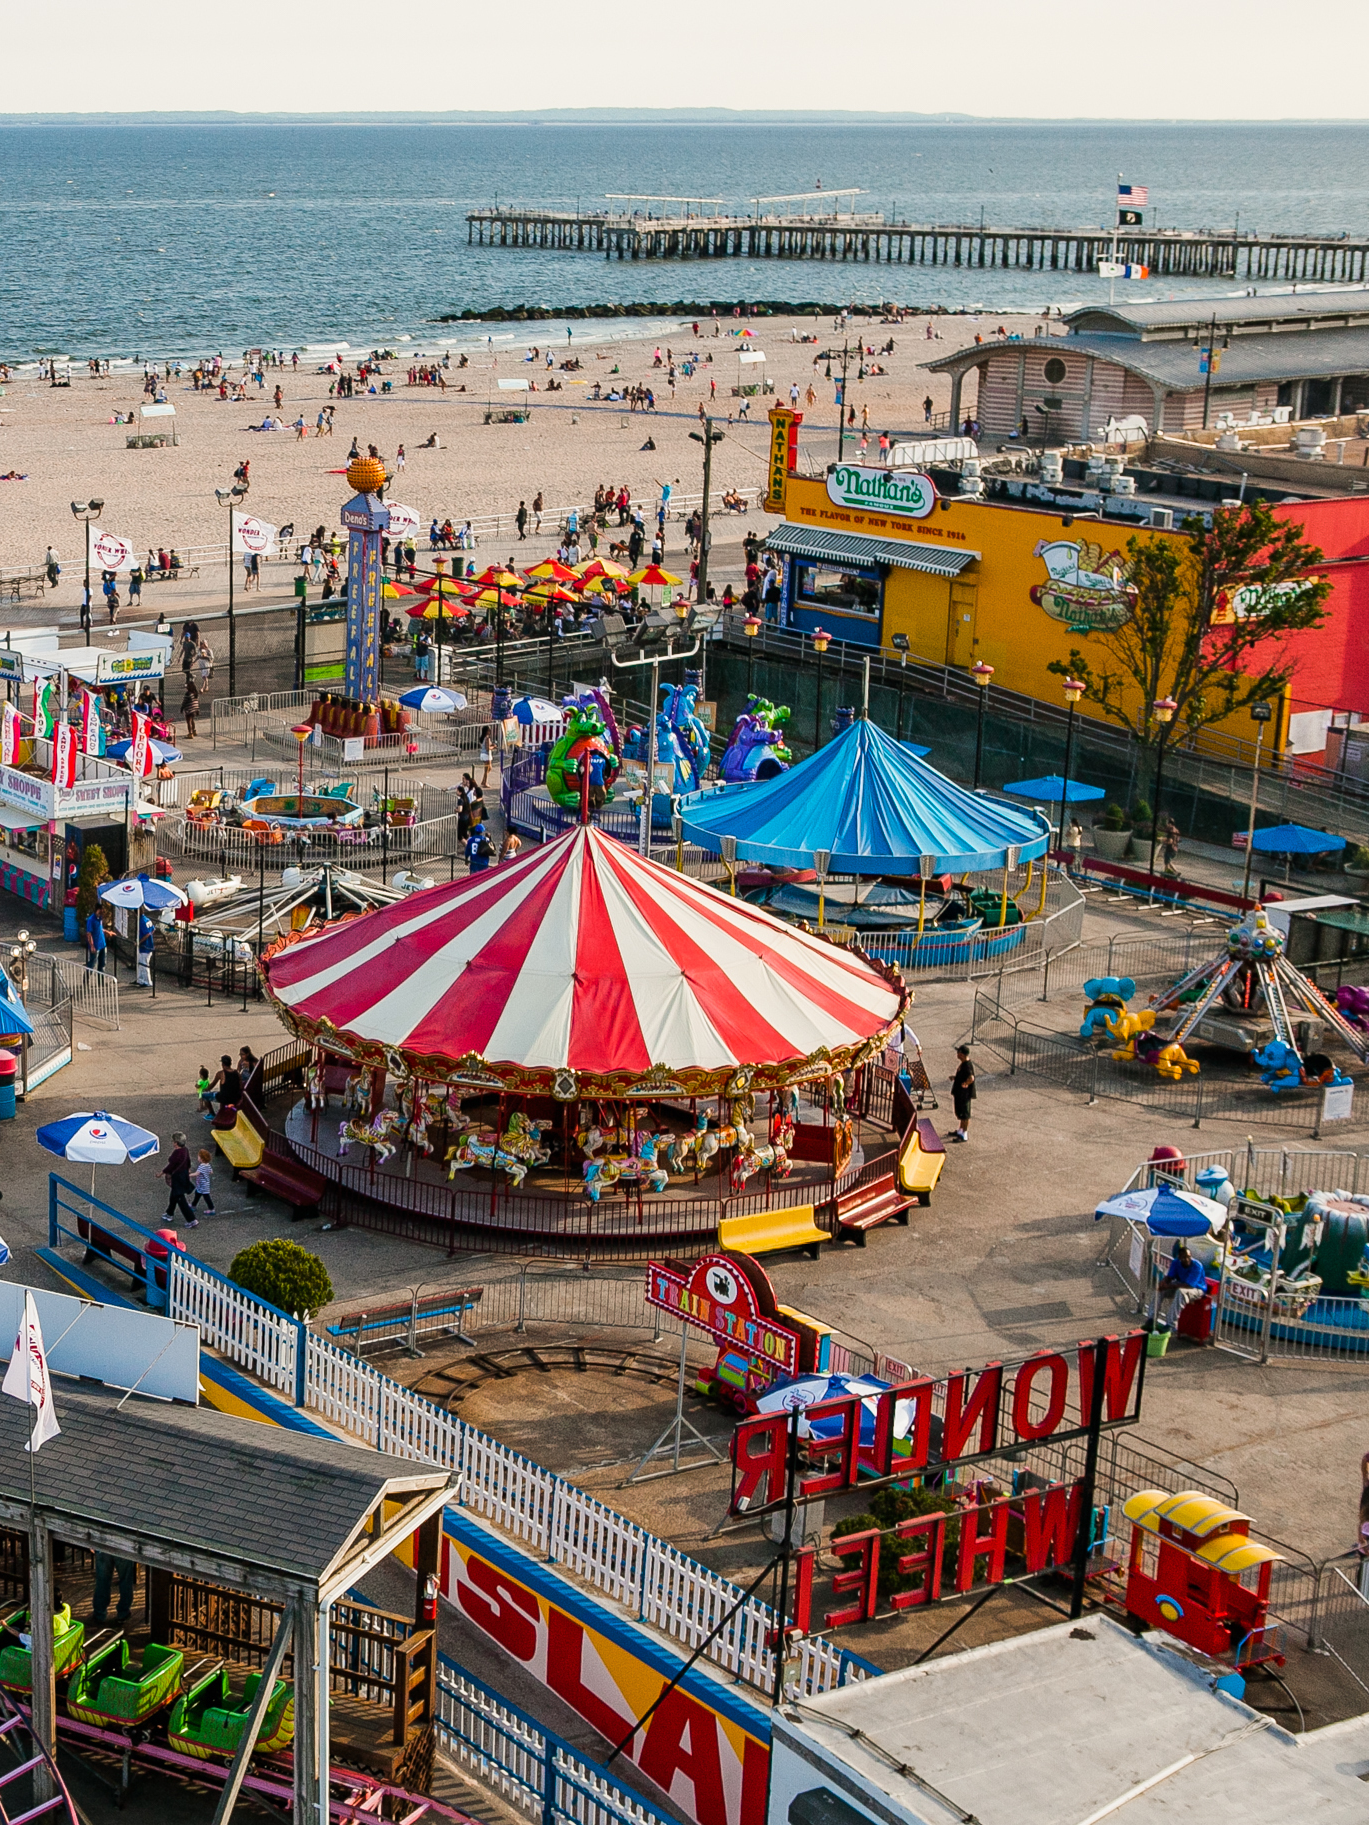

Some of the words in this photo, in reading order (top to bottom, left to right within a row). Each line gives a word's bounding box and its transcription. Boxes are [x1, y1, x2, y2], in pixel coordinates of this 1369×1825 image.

[772, 418, 786, 500] NATHANS
[835, 466, 926, 511] Nathan's
[864, 502, 894, 510] FAMOUS
[344, 511, 368, 526] Deno's
[800, 506, 817, 516] THE
[820, 510, 850, 522] FLAVOR
[854, 515, 865, 524] OF
[868, 517, 887, 527] NEW
[891, 522, 913, 532] YORK
[917, 526, 943, 537] SINCE
[947, 530, 966, 541] 1916
[8, 775, 42, 800] SHOPPE
[1244, 1206, 1266, 1218] EXIT
[1232, 1283, 1255, 1299] EXIT
[656, 1277, 710, 1322] TRAIN
[715, 1306, 786, 1362] STATION
[887, 1360, 904, 1376] EXIT
[933, 1384, 946, 1396] XIT
